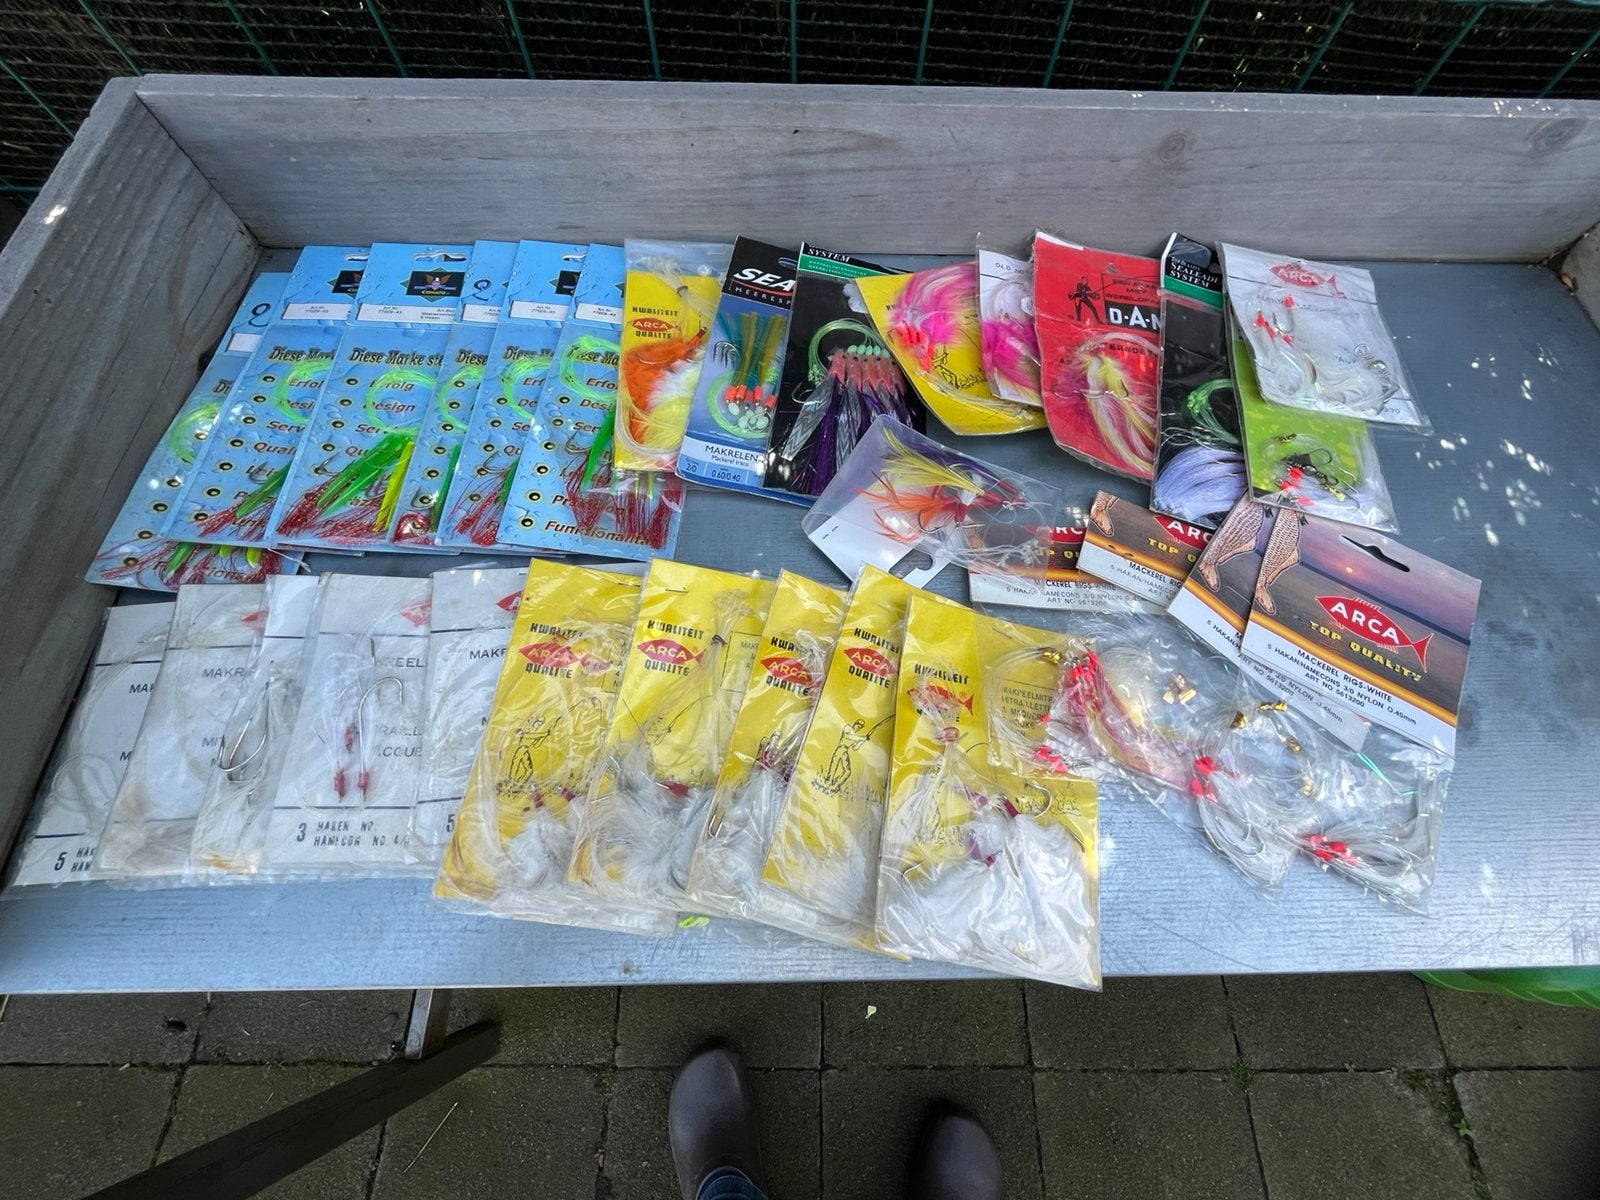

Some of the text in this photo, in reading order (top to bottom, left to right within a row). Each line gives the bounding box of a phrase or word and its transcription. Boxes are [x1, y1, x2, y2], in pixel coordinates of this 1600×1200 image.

[807, 248, 851, 263] SYSTEM
[1170, 270, 1210, 288] SYSTEM
[634, 320, 669, 331] ARCA
[349, 347, 382, 363] Diese
[386, 349, 425, 366] Marke
[1148, 537, 1178, 554] TOP
[1128, 561, 1168, 586] MACKEREL
[647, 619, 704, 640] KWALITEIT
[1330, 600, 1400, 645] ARCA
[645, 646, 689, 661] ARCA
[851, 651, 890, 671] ARCA
[1309, 620, 1422, 683] TOP QUALITY
[643, 659, 690, 677] QUALITE
[768, 660, 808, 680] ARCA
[848, 664, 890, 689] QUALITE
[1252, 664, 1265, 677] NO
[1297, 649, 1393, 703] MACKEREL RIGS-WHITE
[1286, 677, 1314, 702] NYLON
[1304, 671, 1320, 683] ART
[1321, 679, 1334, 691] NO
[1357, 690, 1385, 709] NYLON
[296, 822, 307, 842] 3
[54, 852, 68, 871] 5
